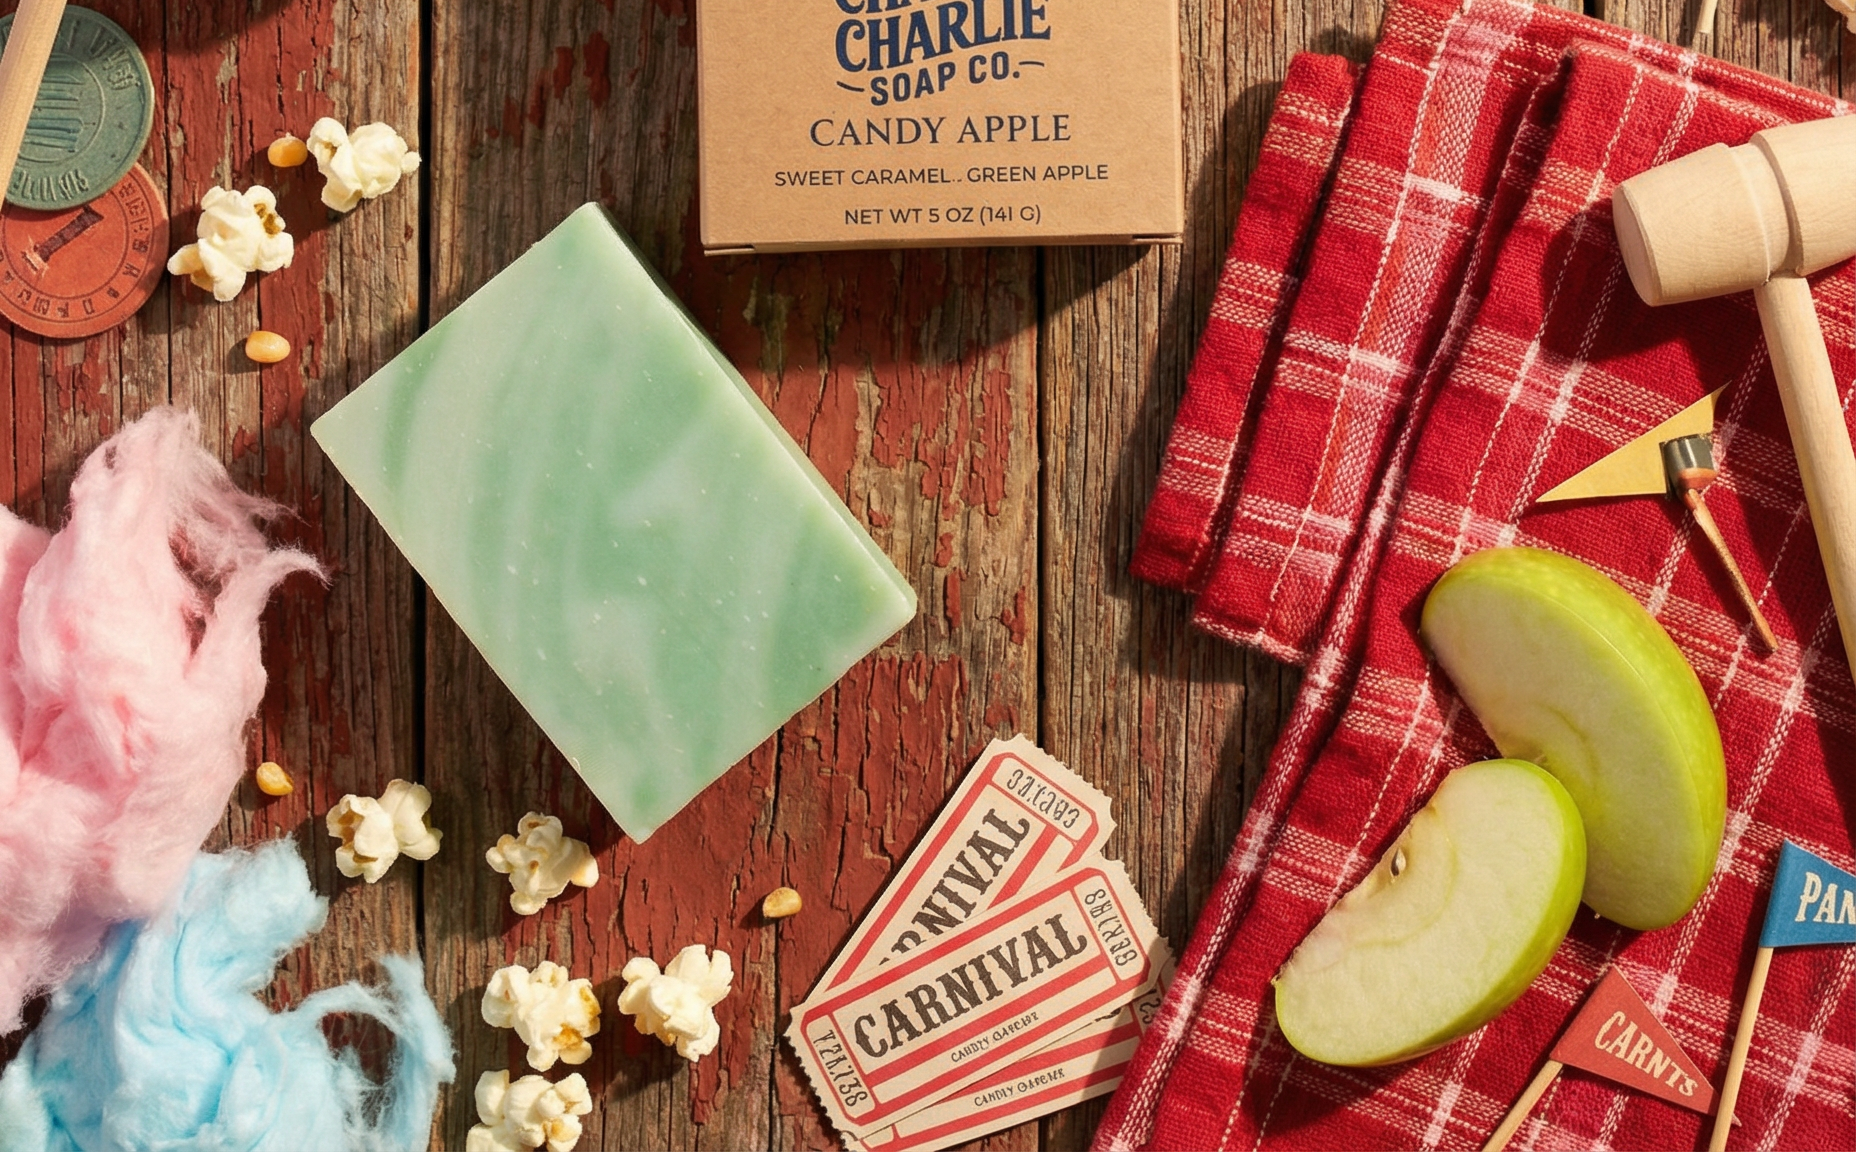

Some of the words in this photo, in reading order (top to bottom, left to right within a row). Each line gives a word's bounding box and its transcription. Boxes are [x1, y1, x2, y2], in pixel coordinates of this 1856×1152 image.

[870, 61, 956, 107] SOAP
[969, 51, 1020, 85] CO.
[809, 116, 946, 147] CANDY
[957, 114, 1072, 144] APPLE
[774, 170, 845, 187] SWEET
[966, 166, 1036, 183] GREEN
[1042, 164, 1109, 181] APPLE
[845, 209, 883, 225] NET
[890, 208, 922, 224] WT
[928, 208, 940, 224] 5
[946, 207, 974, 223] OZ
[979, 206, 1012, 226] (141
[1019, 205, 1041, 225] G)
[879, 808, 1030, 965] RNIVAL
[854, 913, 1089, 1059] CARNIVAL
